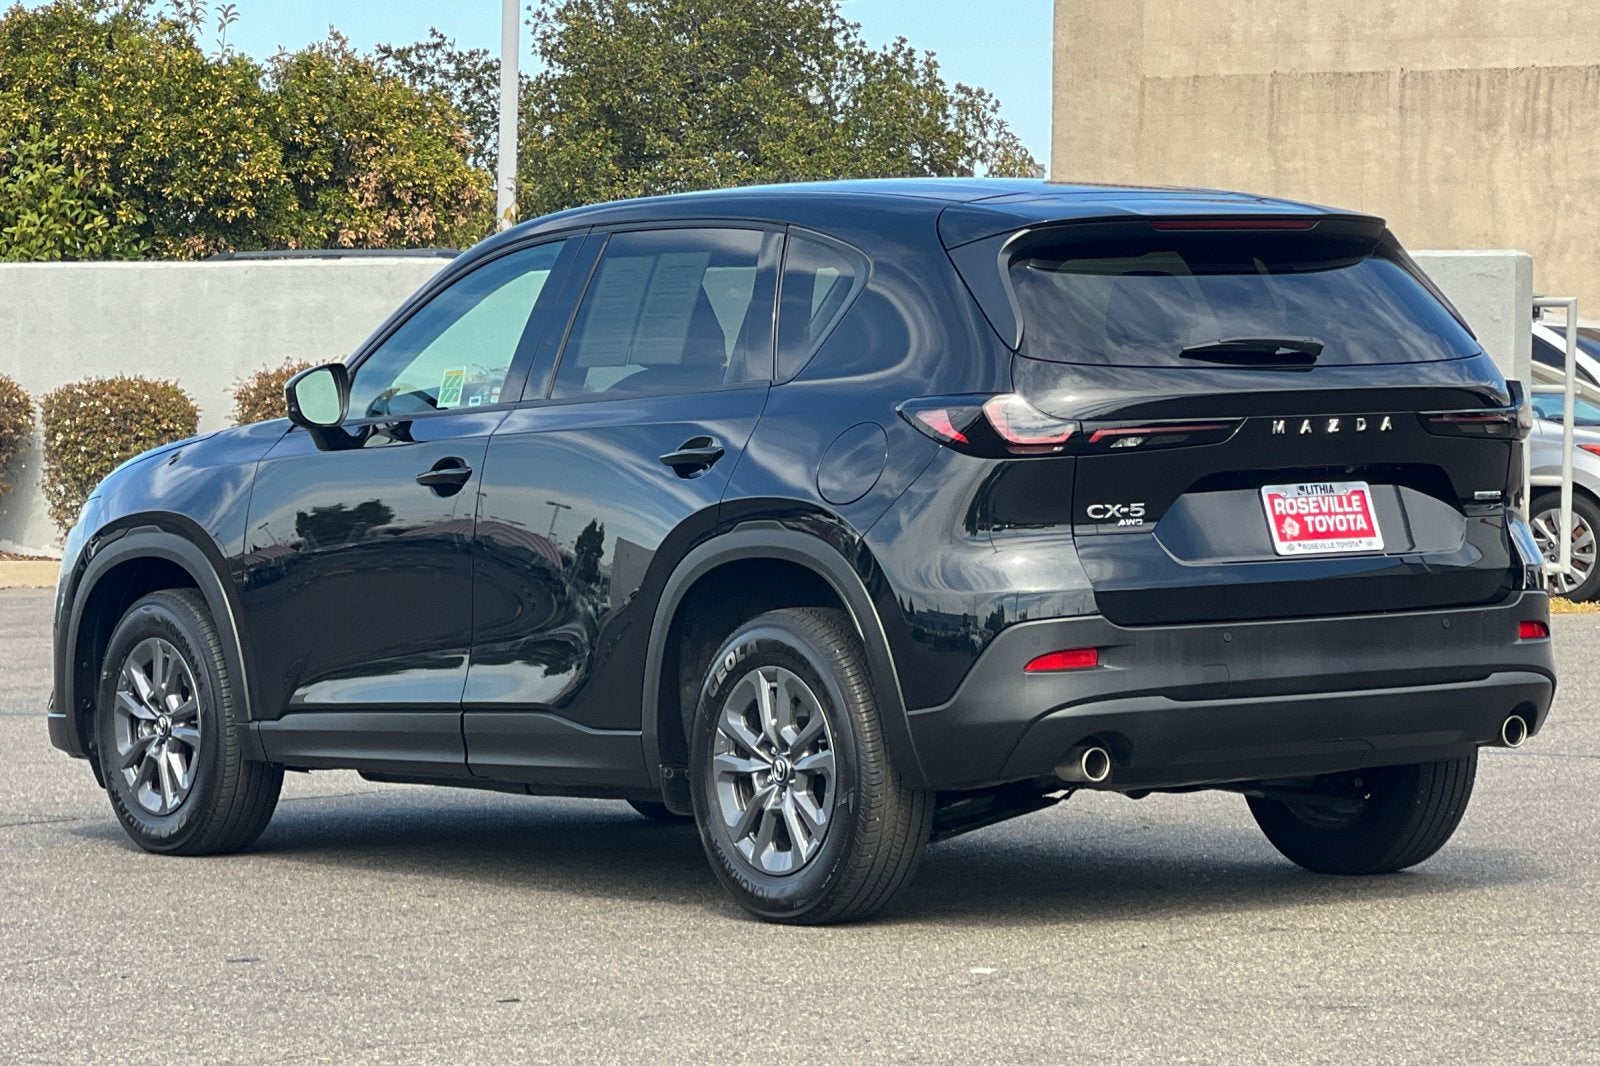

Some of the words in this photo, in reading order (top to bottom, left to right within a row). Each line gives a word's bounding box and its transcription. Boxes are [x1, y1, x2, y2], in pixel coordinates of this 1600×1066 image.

[1271, 416, 1393, 435] MAZDA
[1305, 484, 1335, 495] LITHIA
[1086, 502, 1146, 519] CX-5
[1273, 495, 1362, 516] ROSEVILLE
[1117, 518, 1144, 527] AWD
[1303, 514, 1368, 533] TOYOTA
[1302, 542, 1335, 551] ROSEVILLE
[1336, 541, 1359, 549] TOYOTA
